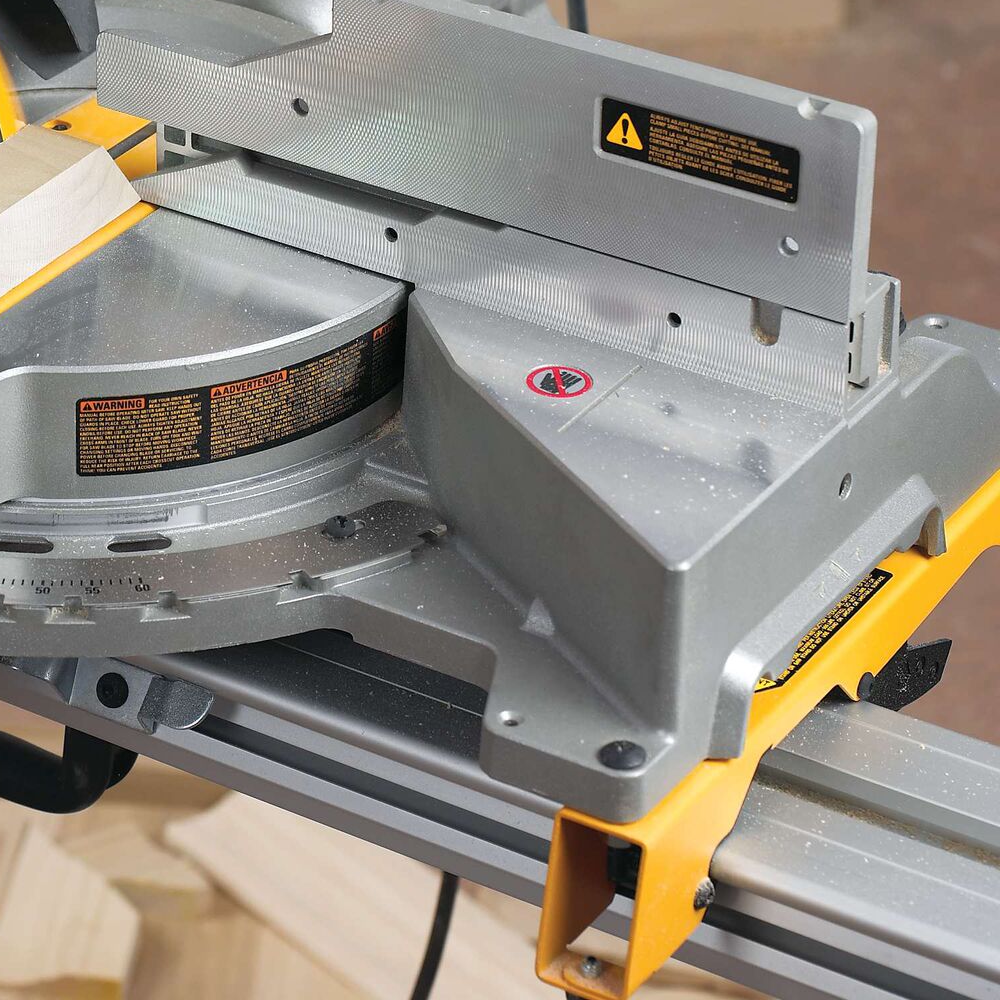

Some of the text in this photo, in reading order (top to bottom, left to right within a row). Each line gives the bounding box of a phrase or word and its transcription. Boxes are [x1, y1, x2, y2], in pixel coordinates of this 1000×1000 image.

[223, 372, 284, 395] ADVERTENCIA
[93, 400, 142, 411] WARNING
[35, 586, 51, 595] 50
[84, 586, 100, 595] 55
[135, 584, 150, 592] 60
